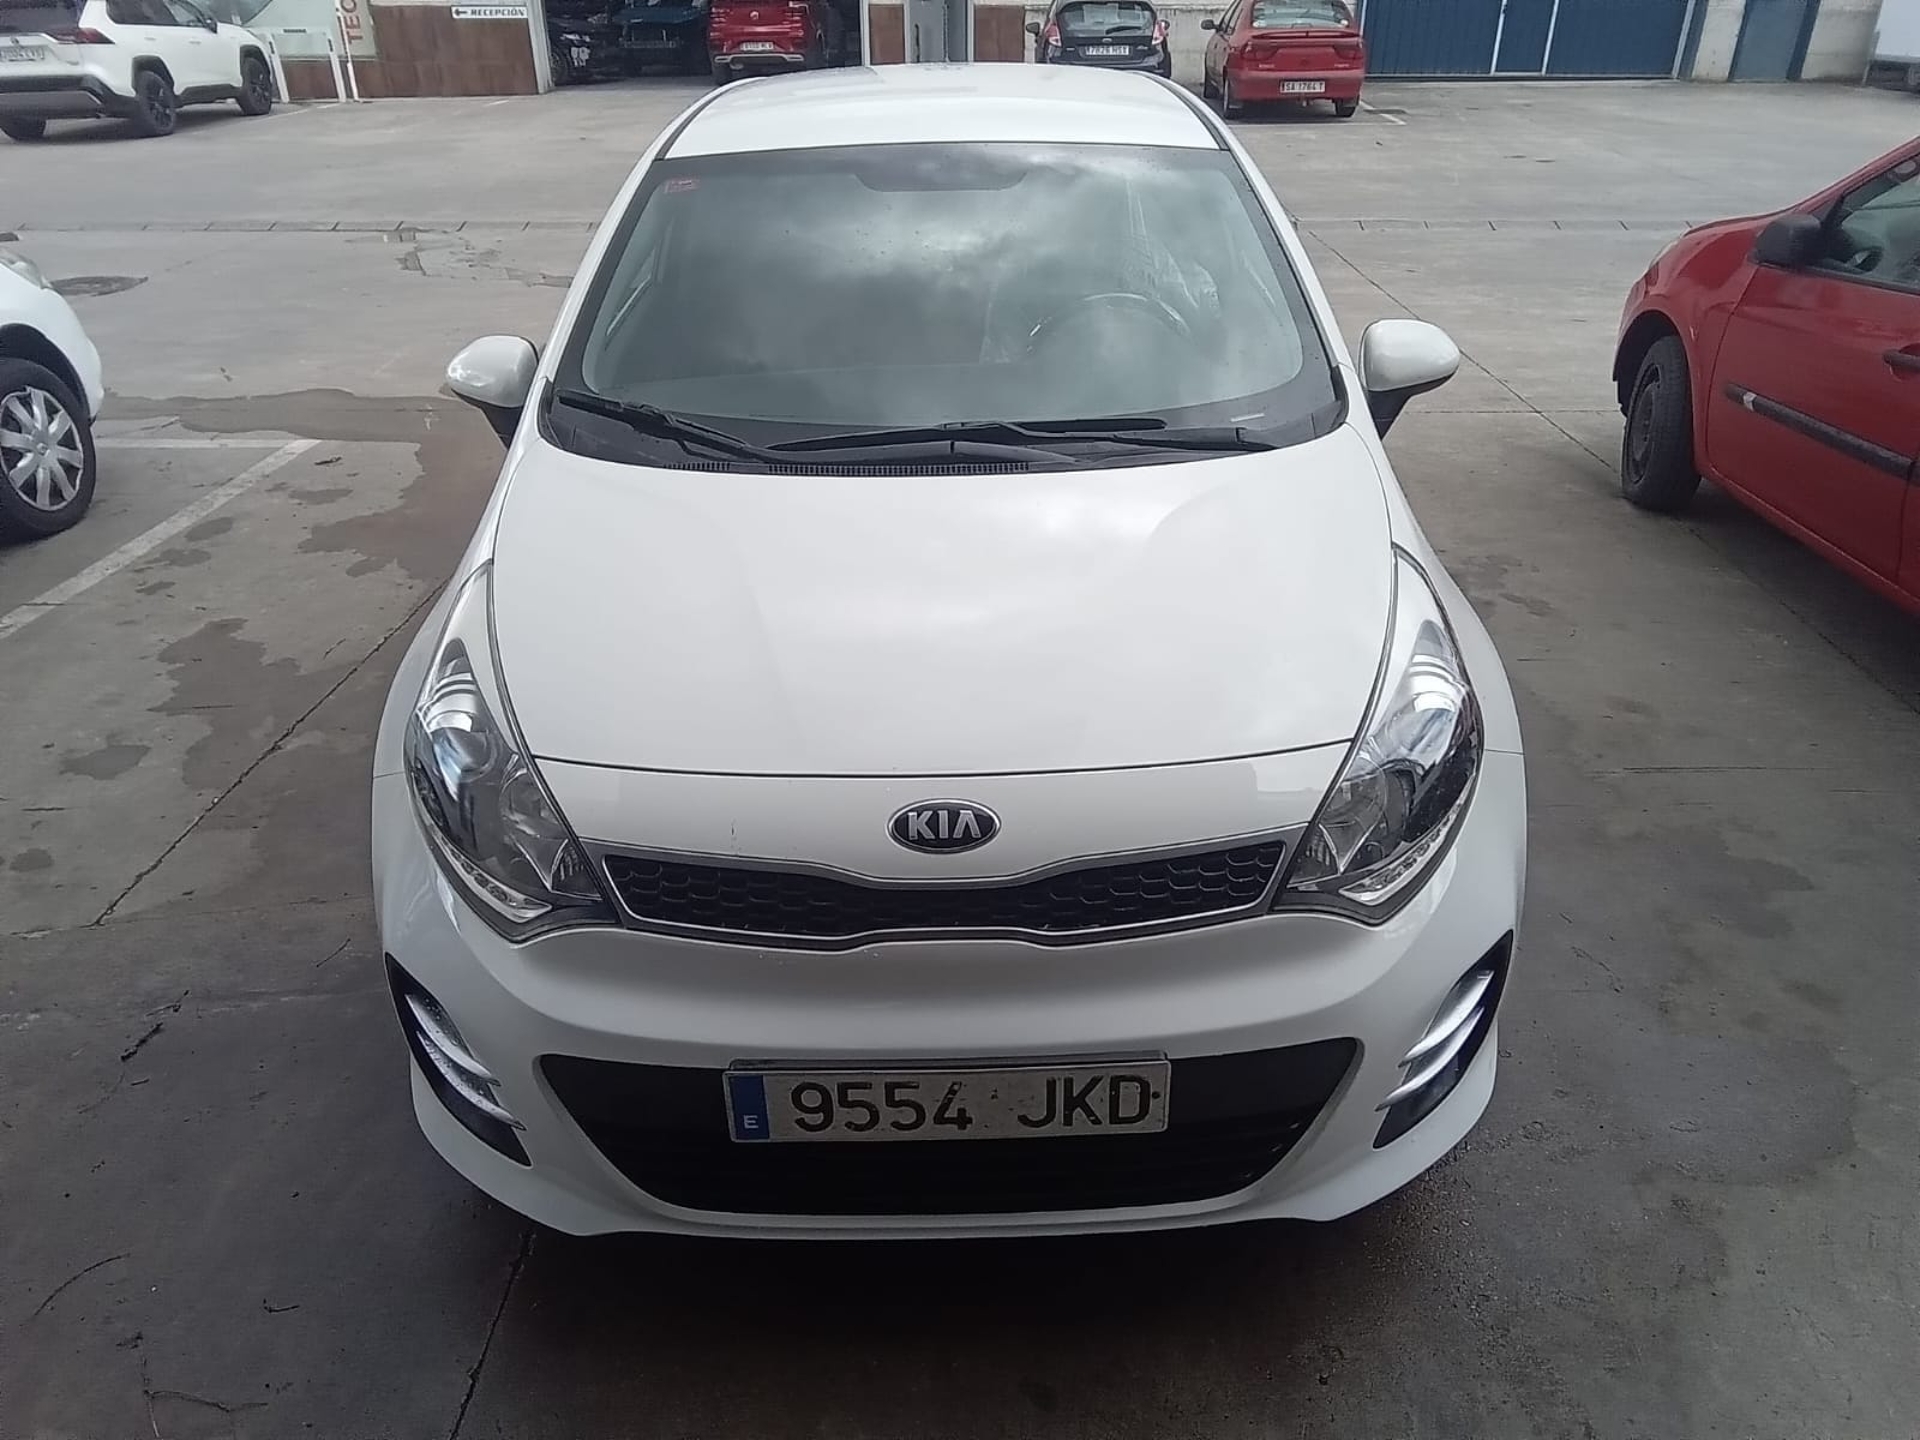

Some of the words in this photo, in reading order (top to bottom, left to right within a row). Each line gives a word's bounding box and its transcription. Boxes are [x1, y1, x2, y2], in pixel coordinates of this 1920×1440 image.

[470, 7, 525, 16] RECEPCIÓN
[907, 809, 982, 840] KIA
[743, 1114, 759, 1129] E
[789, 1080, 973, 1132] 9554
[1016, 1074, 1152, 1129] JKD
